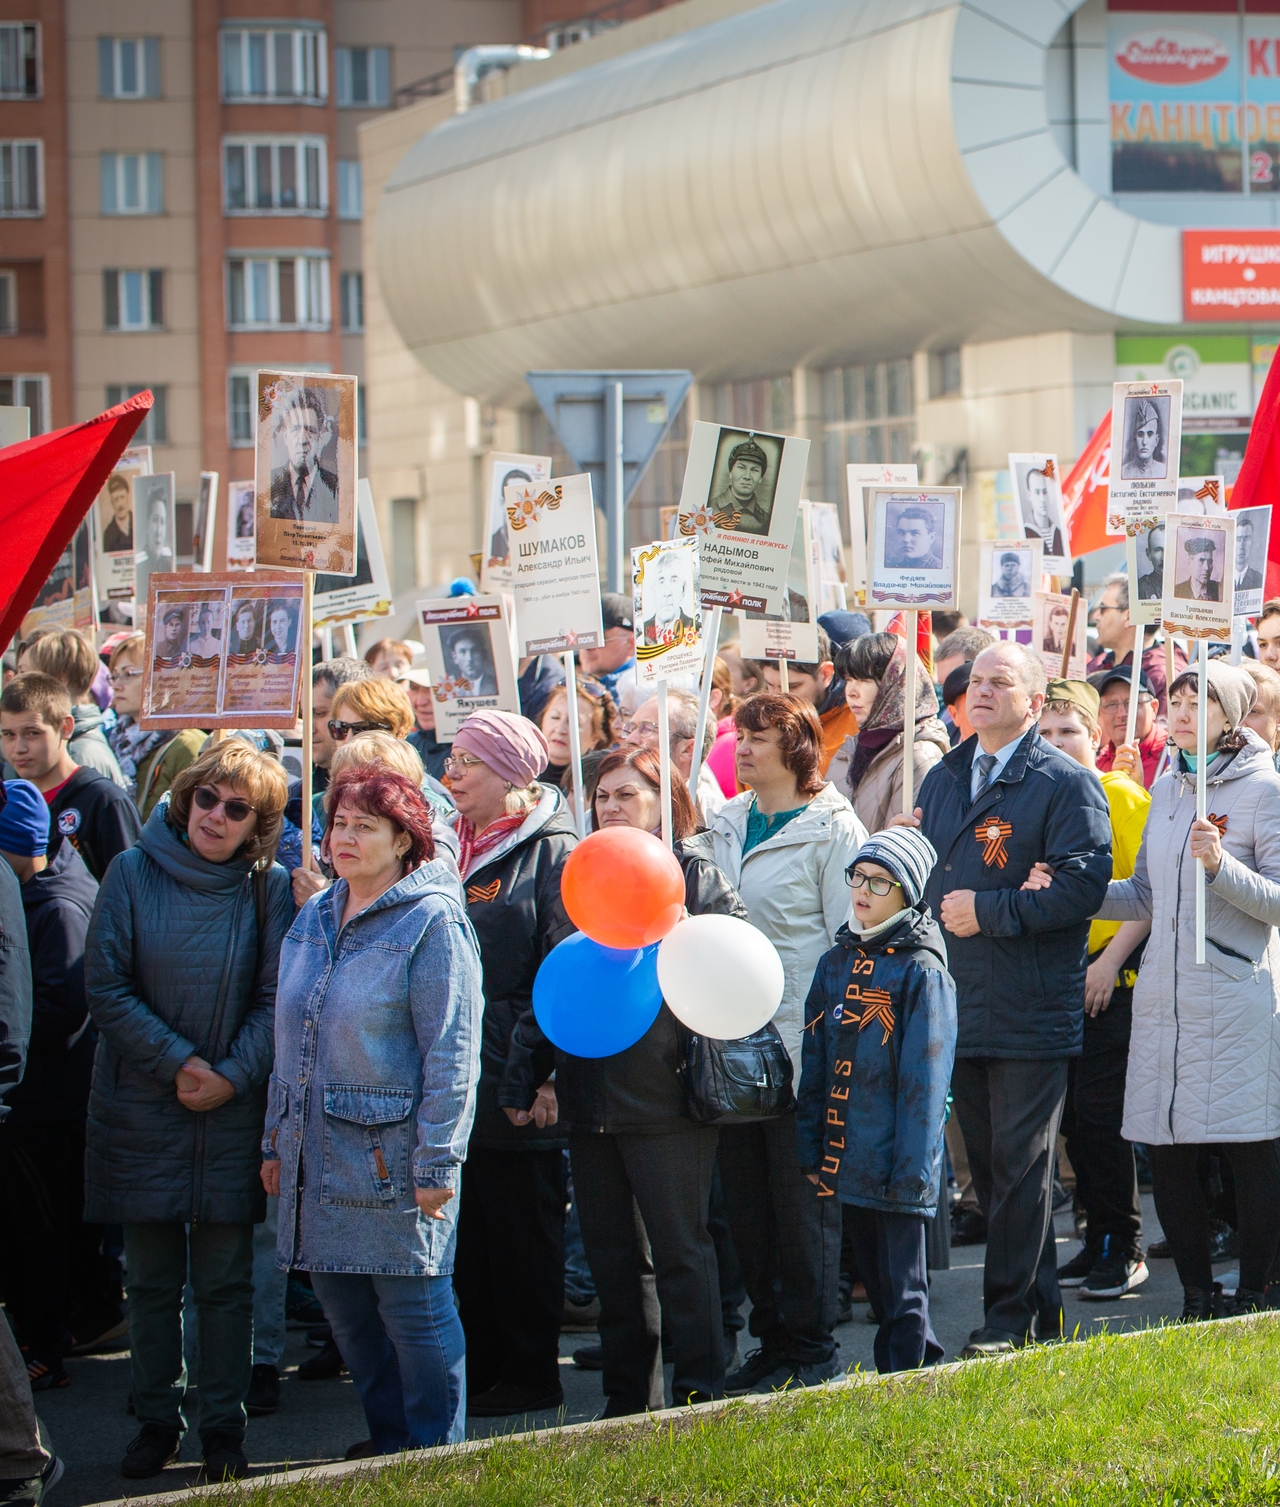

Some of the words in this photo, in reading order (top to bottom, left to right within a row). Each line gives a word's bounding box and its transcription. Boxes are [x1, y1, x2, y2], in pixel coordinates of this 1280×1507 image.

[1252, 153, 1273, 182] 2
[1182, 391, 1238, 409] RGANIC
[1110, 490, 1138, 498] Евстигней
[1139, 490, 1177, 498] Евстигнеевич
[1132, 498, 1153, 506] рядовой
[518, 535, 586, 558] ШУМАКОВ
[721, 534, 750, 544] ПОМНЮ!
[755, 540, 789, 550] ГОРЖУСЬ!
[703, 543, 760, 560] НАДЫМОВ
[517, 559, 563, 574] Александр
[564, 554, 592, 567] Ильич
[723, 558, 775, 573] Михайлович
[713, 566, 743, 576] рядовой
[515, 580, 536, 589] старший
[536, 578, 557, 586] сержант,
[558, 574, 579, 583] морская
[579, 572, 596, 580] пехота
[719, 575, 730, 583] без
[730, 578, 747, 586] вести
[765, 584, 779, 592] году
[899, 574, 926, 582] Федяев
[873, 581, 908, 590] Владимир
[909, 581, 952, 590] Михайлович
[1234, 591, 1250, 601] АНИН
[741, 598, 763, 608] полк
[1234, 599, 1261, 608] ЕФИМОВИЧ
[1170, 611, 1194, 620] Василий
[1195, 615, 1229, 624] Алексеевич
[577, 635, 595, 644] полк
[658, 661, 679, 671] Григорий
[456, 699, 498, 709] Якушев
[816, 1059, 852, 1198] VULPES
[841, 958, 875, 1026] VPS
